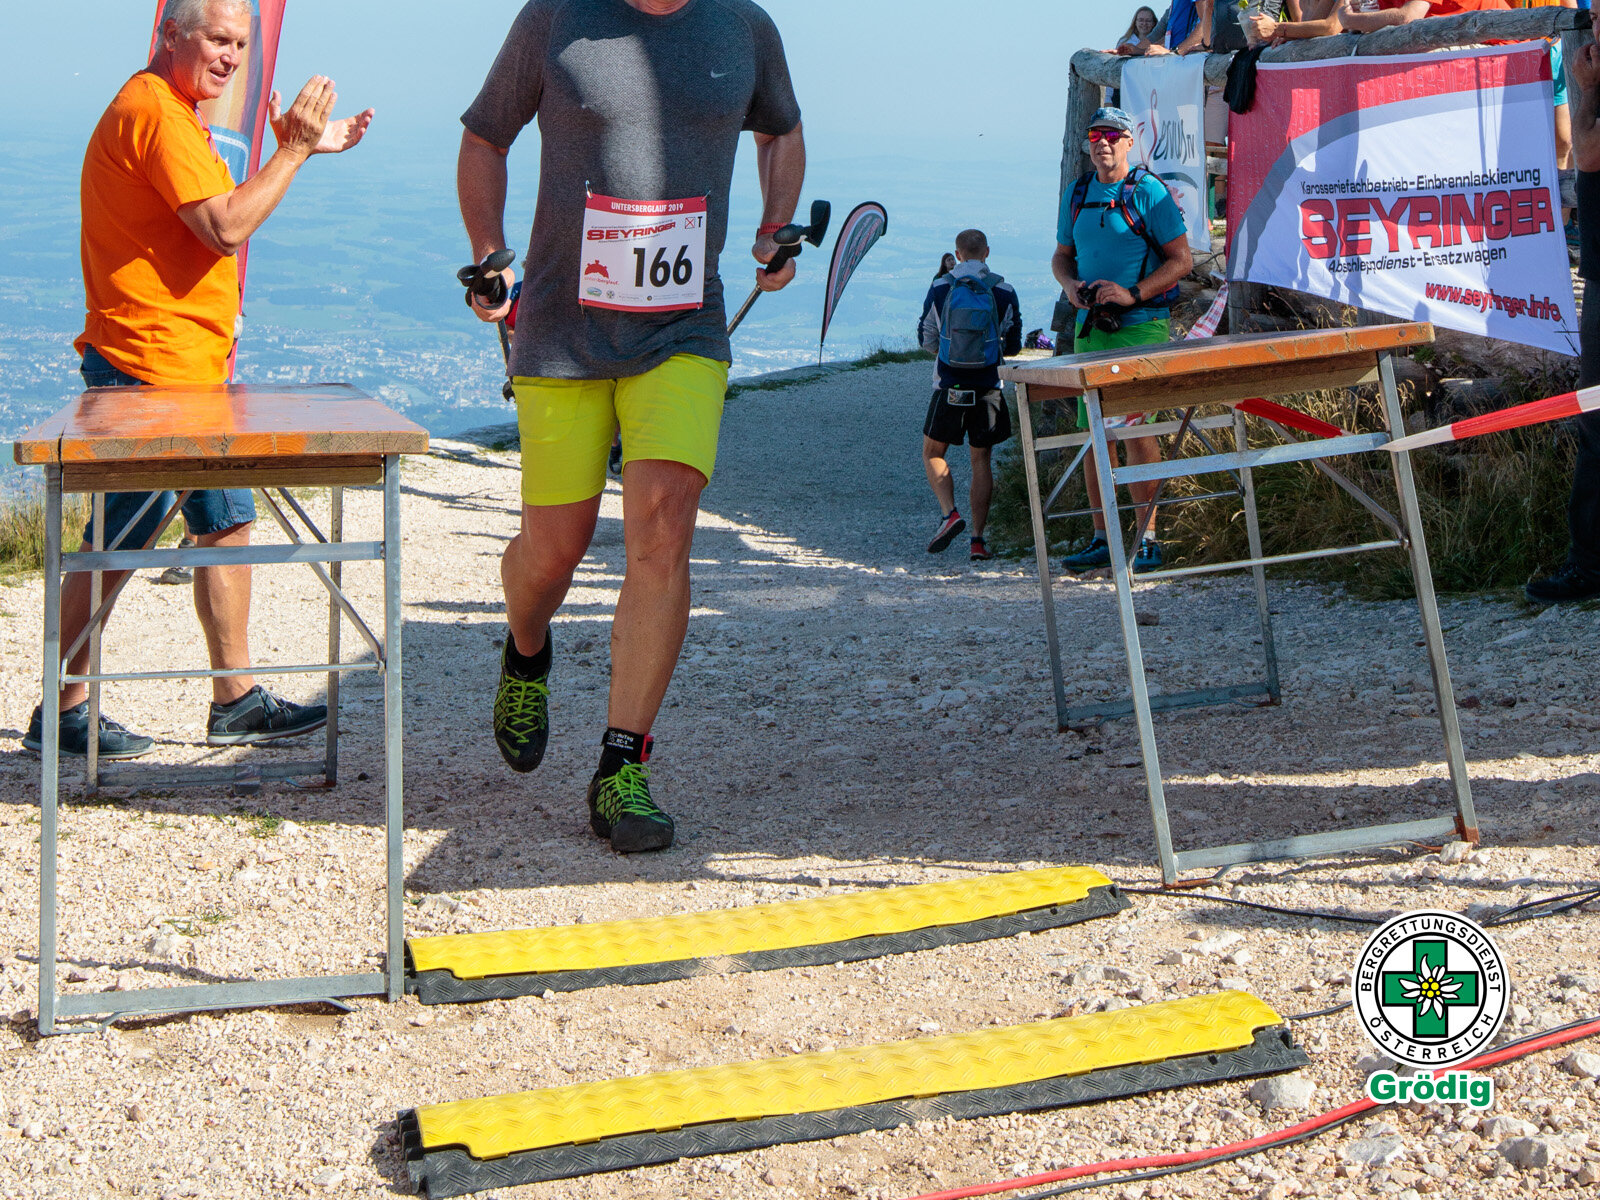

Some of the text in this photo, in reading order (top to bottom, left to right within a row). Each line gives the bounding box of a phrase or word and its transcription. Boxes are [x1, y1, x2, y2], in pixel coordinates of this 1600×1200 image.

[611, 201, 684, 213] UNTERSBERGLAUF 2019
[1299, 186, 1556, 260] SEYRINGER
[586, 221, 676, 241] SEYRINGER
[633, 244, 693, 288] 166
